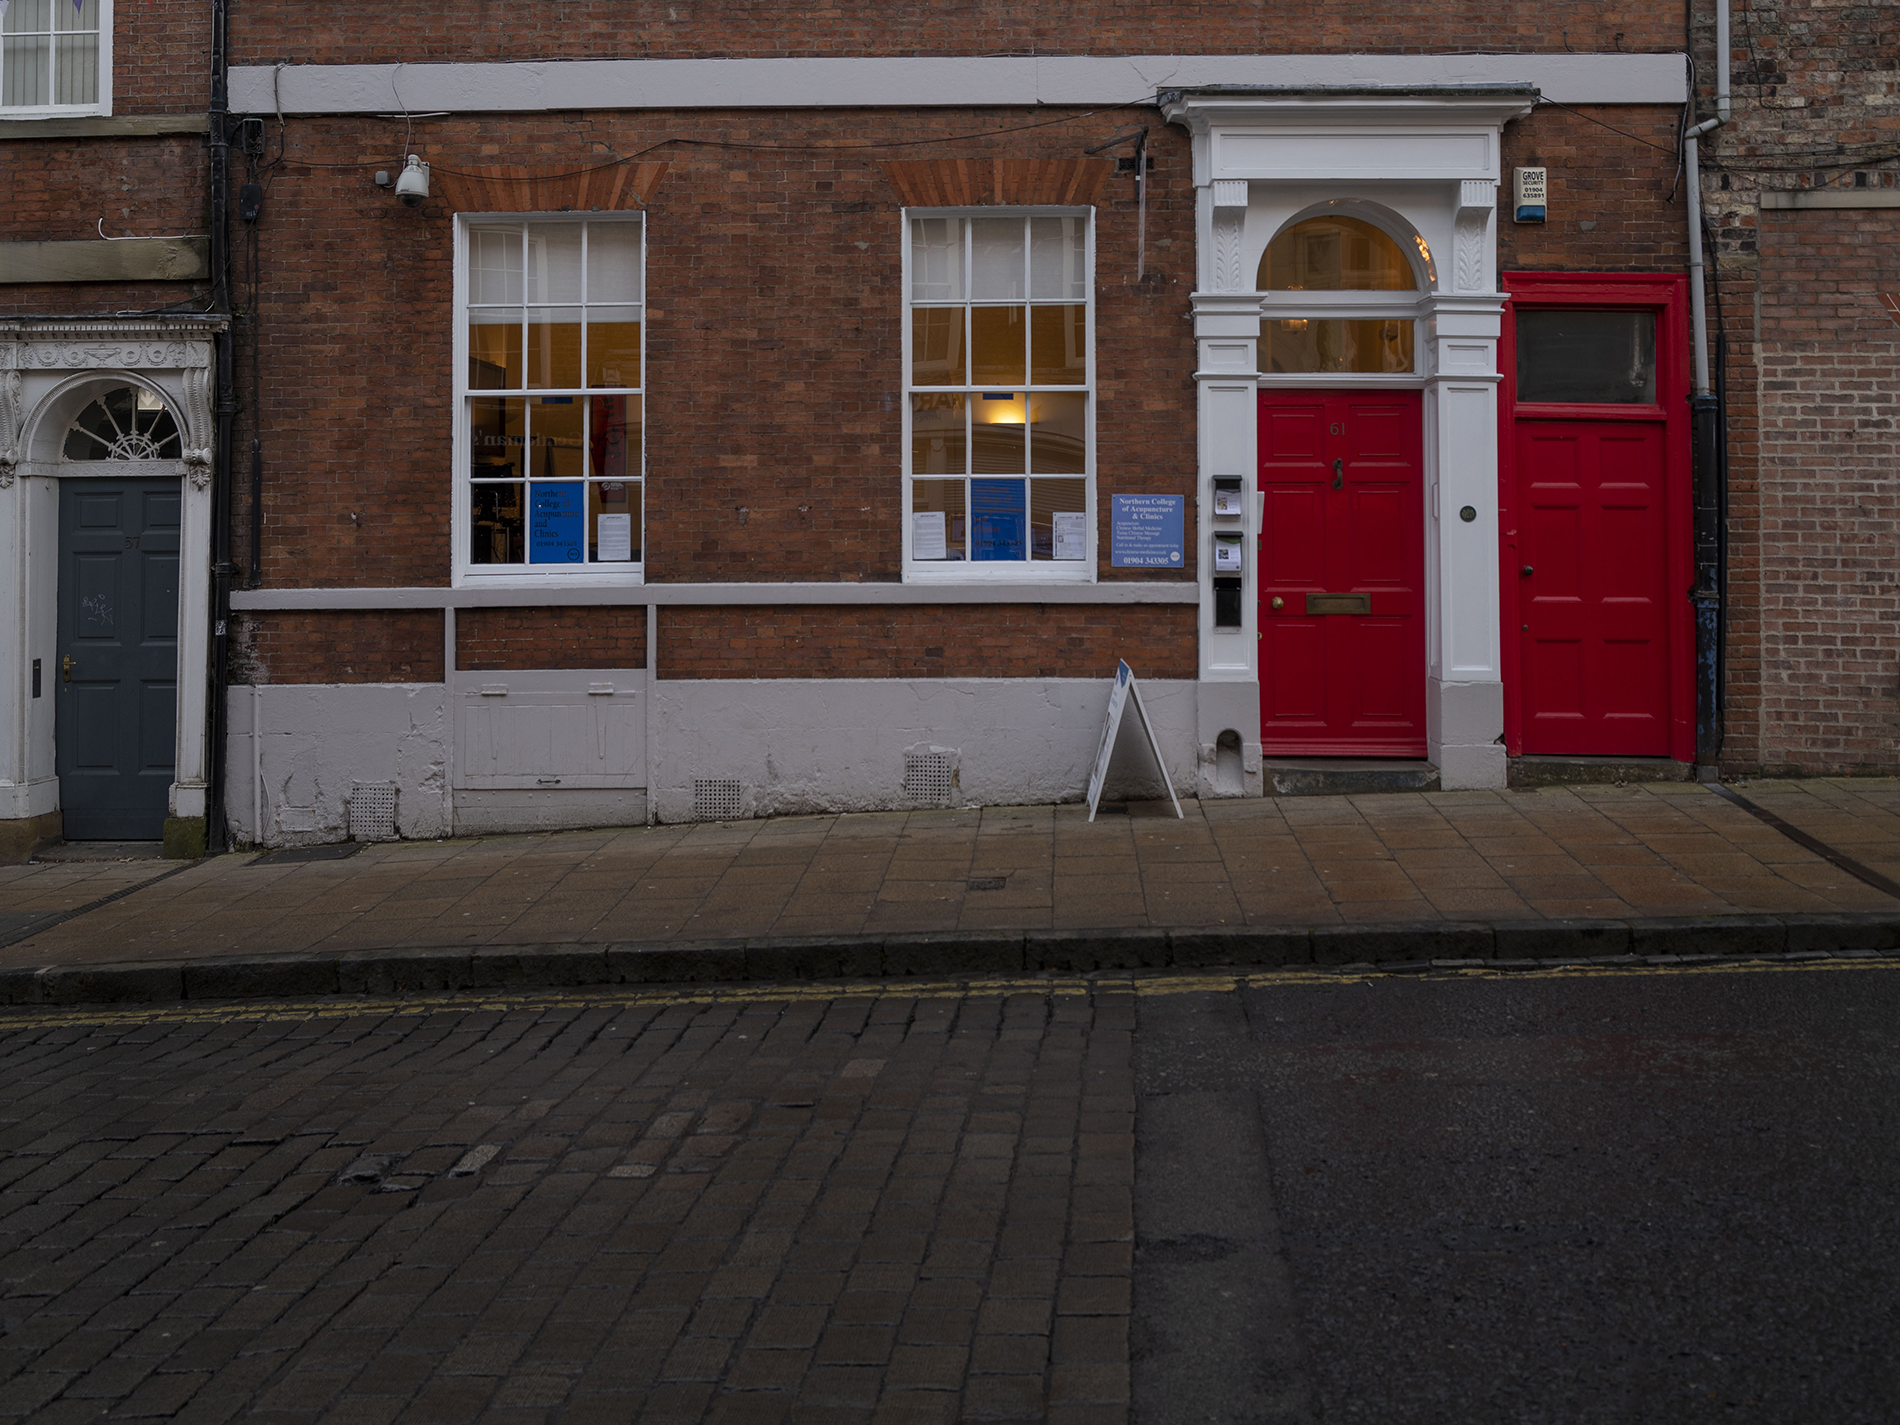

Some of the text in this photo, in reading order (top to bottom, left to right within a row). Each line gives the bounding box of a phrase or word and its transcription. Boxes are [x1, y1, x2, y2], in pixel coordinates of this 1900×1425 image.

[1523, 171, 1544, 180] GROVE
[1330, 422, 1345, 436] 61
[534, 489, 567, 497] Northern
[1003, 495, 1013, 503] of
[1151, 498, 1176, 506] College
[534, 498, 571, 510] College of
[534, 510, 579, 520] Acupuncture
[974, 506, 1024, 515] Acupuncture
[534, 519, 547, 527] and
[973, 515, 988, 523] and
[534, 529, 559, 538] Clinics
[125, 535, 141, 549] 57
[1145, 557, 1169, 565] 343305
